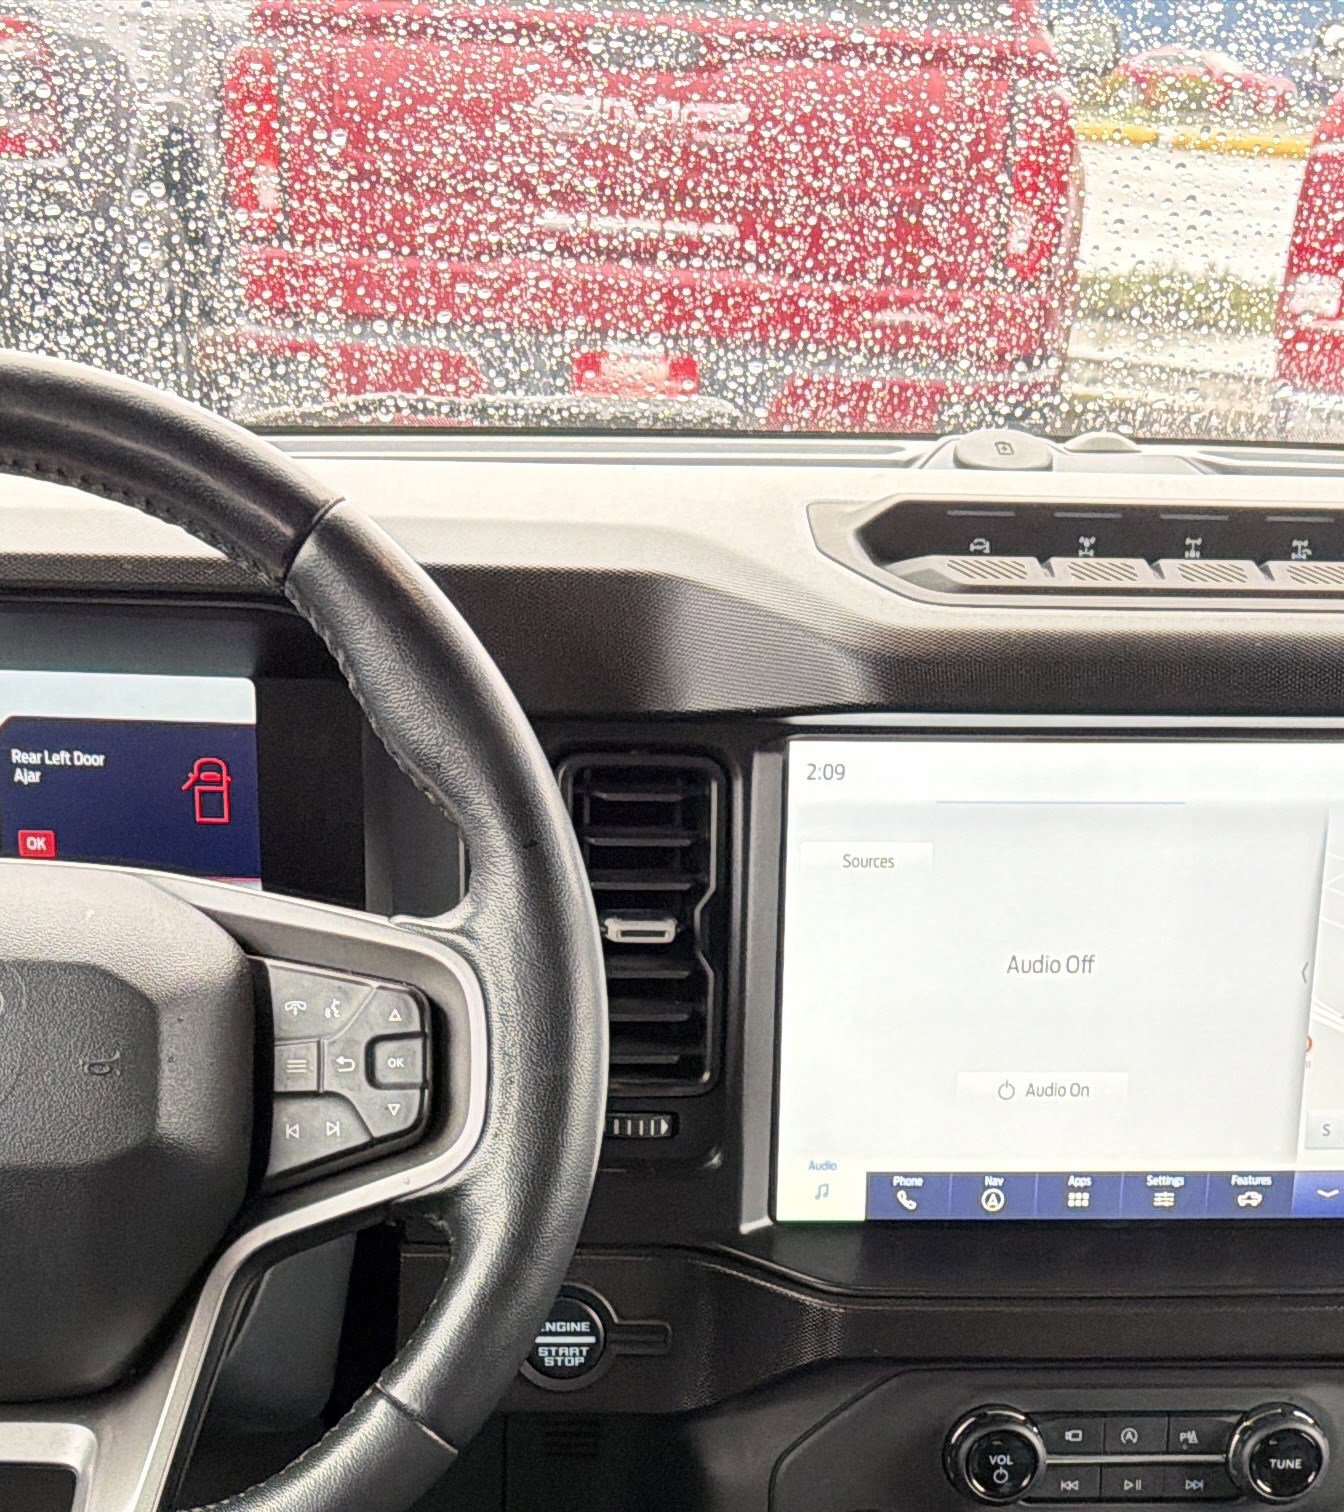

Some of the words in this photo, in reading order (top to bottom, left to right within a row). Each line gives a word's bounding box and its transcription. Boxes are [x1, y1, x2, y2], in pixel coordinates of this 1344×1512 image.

[11, 749, 42, 764] Rear
[44, 750, 71, 765] Left
[73, 751, 105, 766] Door
[14, 768, 41, 785] Ajar
[806, 763, 846, 781] 2:09
[26, 837, 47, 850] OK
[842, 854, 895, 868] Sources
[1007, 954, 1061, 974] Audio
[1066, 954, 1096, 974] Off
[387, 1058, 405, 1068] OK
[1025, 1082, 1066, 1097] Audio
[1070, 1082, 1090, 1097] On
[1322, 1123, 1331, 1136] S
[808, 1161, 837, 1171] Audio
[892, 1175, 923, 1187] Phone
[984, 1175, 1004, 1187] Nav
[1067, 1175, 1092, 1188] Apps
[1146, 1175, 1184, 1188] Settings
[1231, 1175, 1273, 1187] Features
[541, 1321, 590, 1332] NGINE
[538, 1347, 590, 1356] START
[544, 1357, 585, 1366] STOP
[989, 1455, 1013, 1466] VOL
[1269, 1459, 1302, 1470] TUNE
